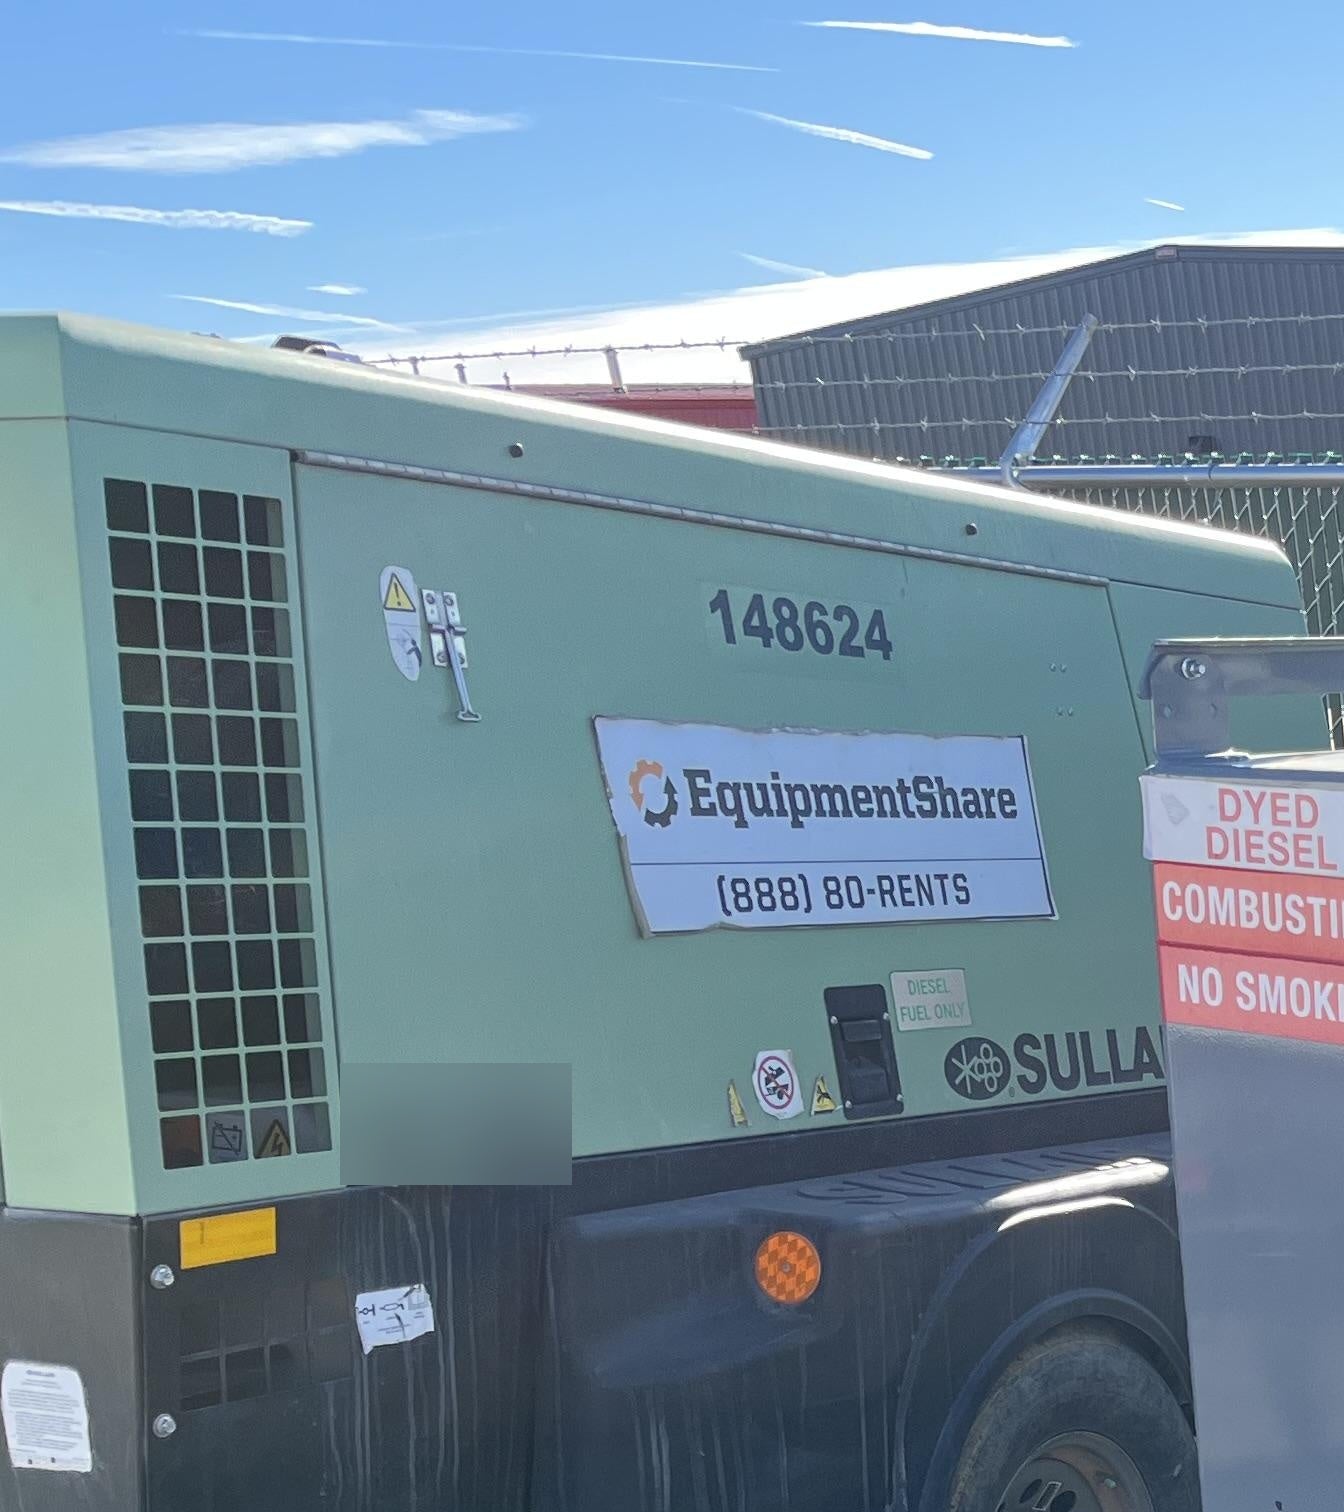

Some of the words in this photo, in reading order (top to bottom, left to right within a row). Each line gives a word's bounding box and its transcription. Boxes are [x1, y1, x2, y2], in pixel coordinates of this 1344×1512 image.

[709, 589, 893, 661] 148624
[683, 769, 1018, 829] EquipmentShare
[1218, 787, 1320, 830] DYED
[1205, 825, 1339, 872] DIESEL
[717, 873, 812, 917] (888)
[823, 872, 971, 910] 80-RENTS
[907, 978, 950, 996] DIESEL
[1177, 963, 1222, 1006] NO
[900, 1003, 932, 1023] FUEL
[935, 1000, 966, 1021] ONLY
[1013, 1024, 1164, 1095] SULLA
